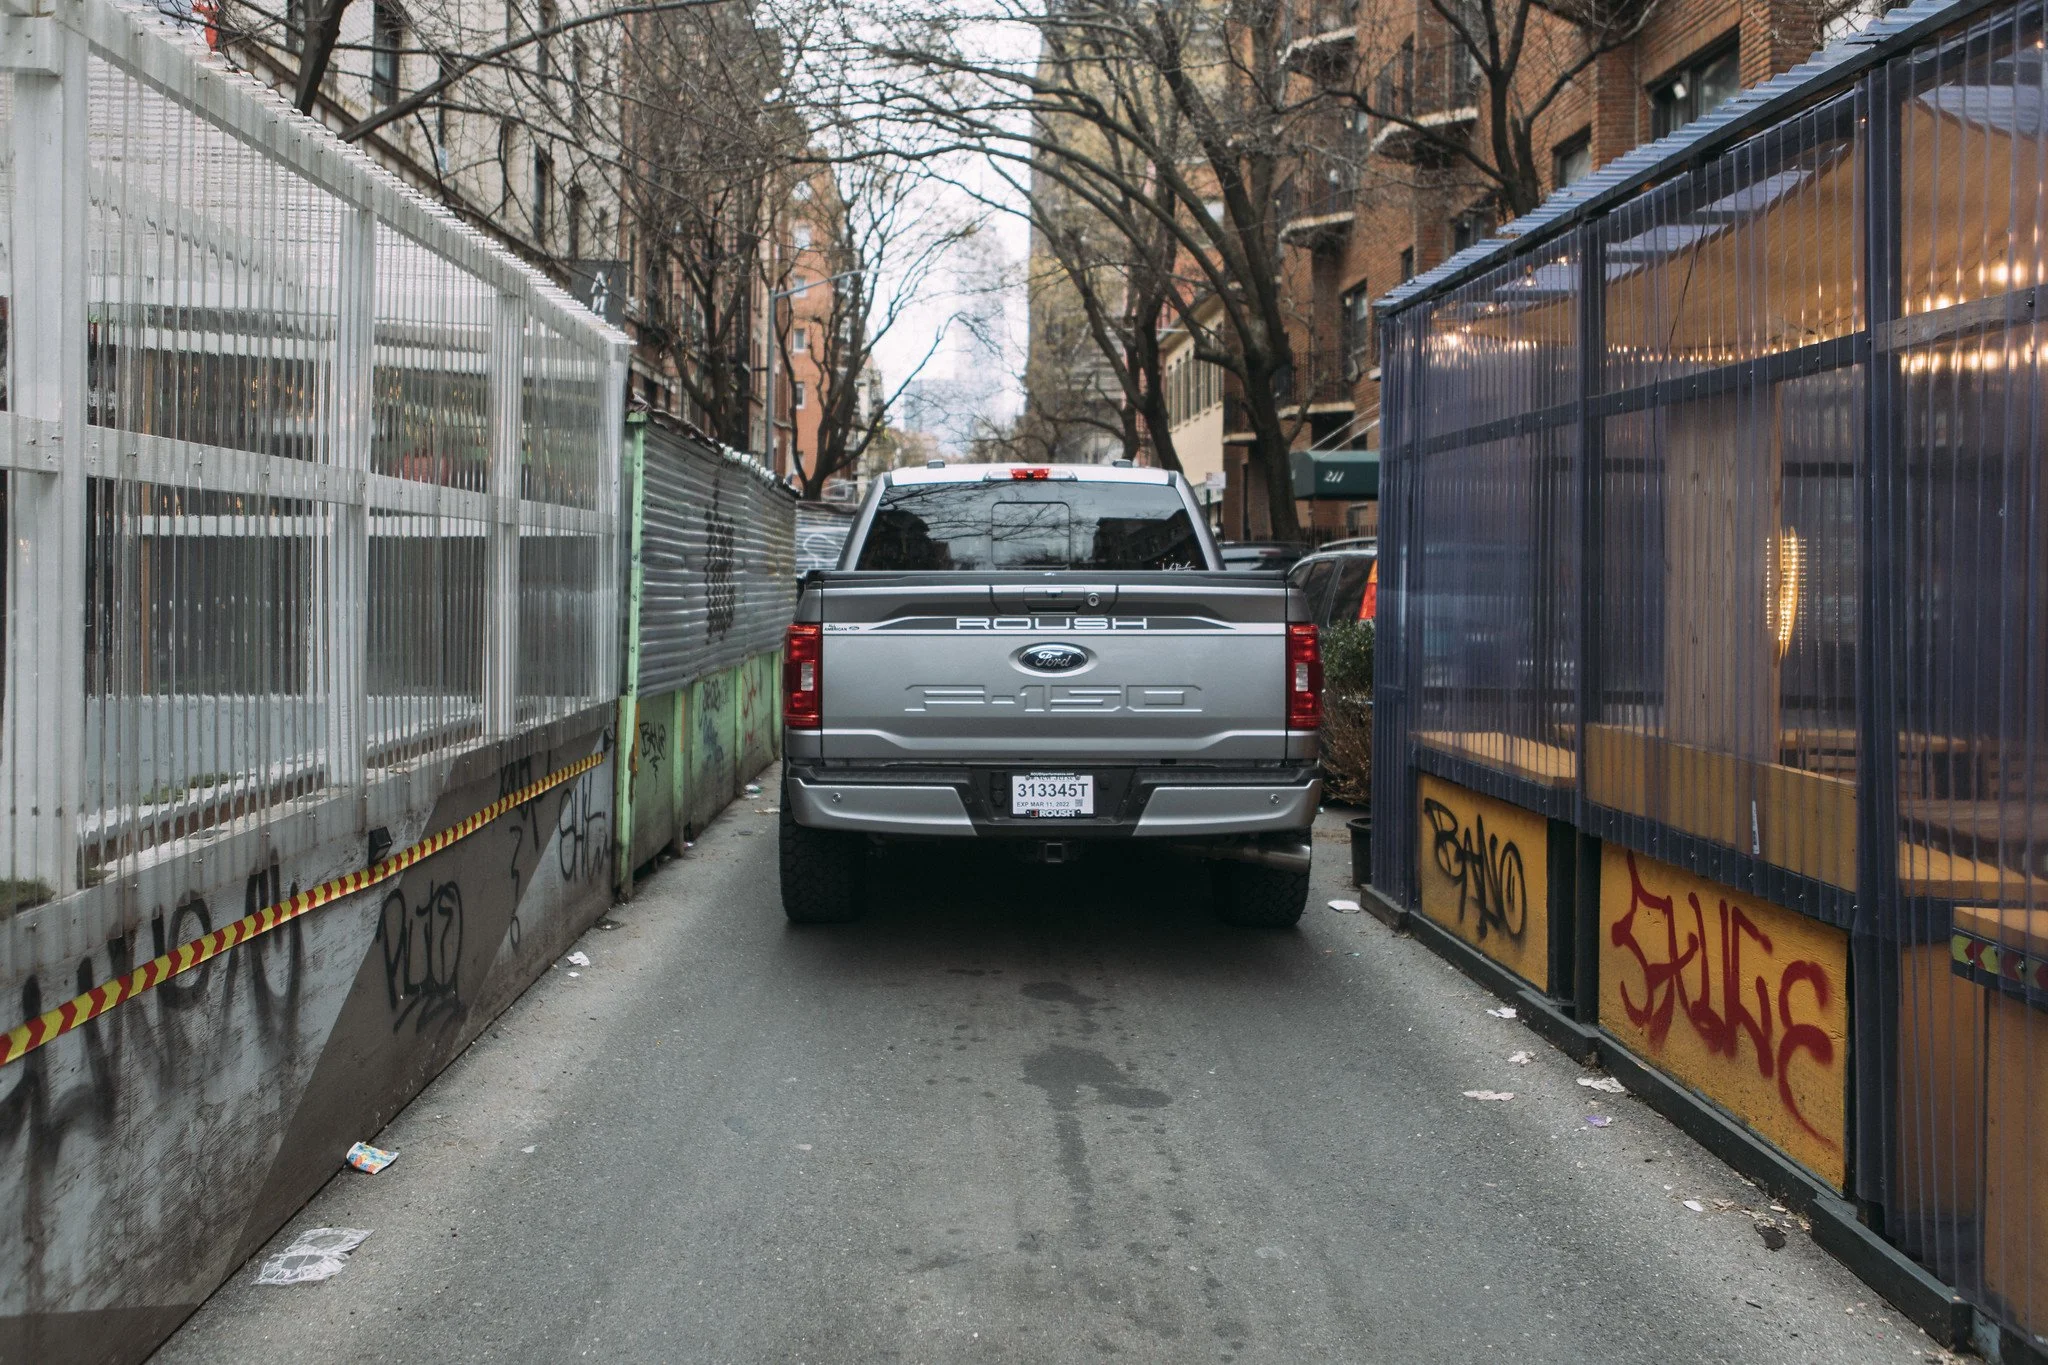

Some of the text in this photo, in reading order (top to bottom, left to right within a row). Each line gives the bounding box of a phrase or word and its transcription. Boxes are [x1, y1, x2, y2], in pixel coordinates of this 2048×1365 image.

[1324, 471, 1345, 483] 211
[955, 618, 1148, 630] ROUSH
[1035, 650, 1072, 668] Ford
[905, 684, 1203, 713] F-150
[1017, 783, 1089, 798] 313345T
[1038, 809, 1076, 818] ROUSH
